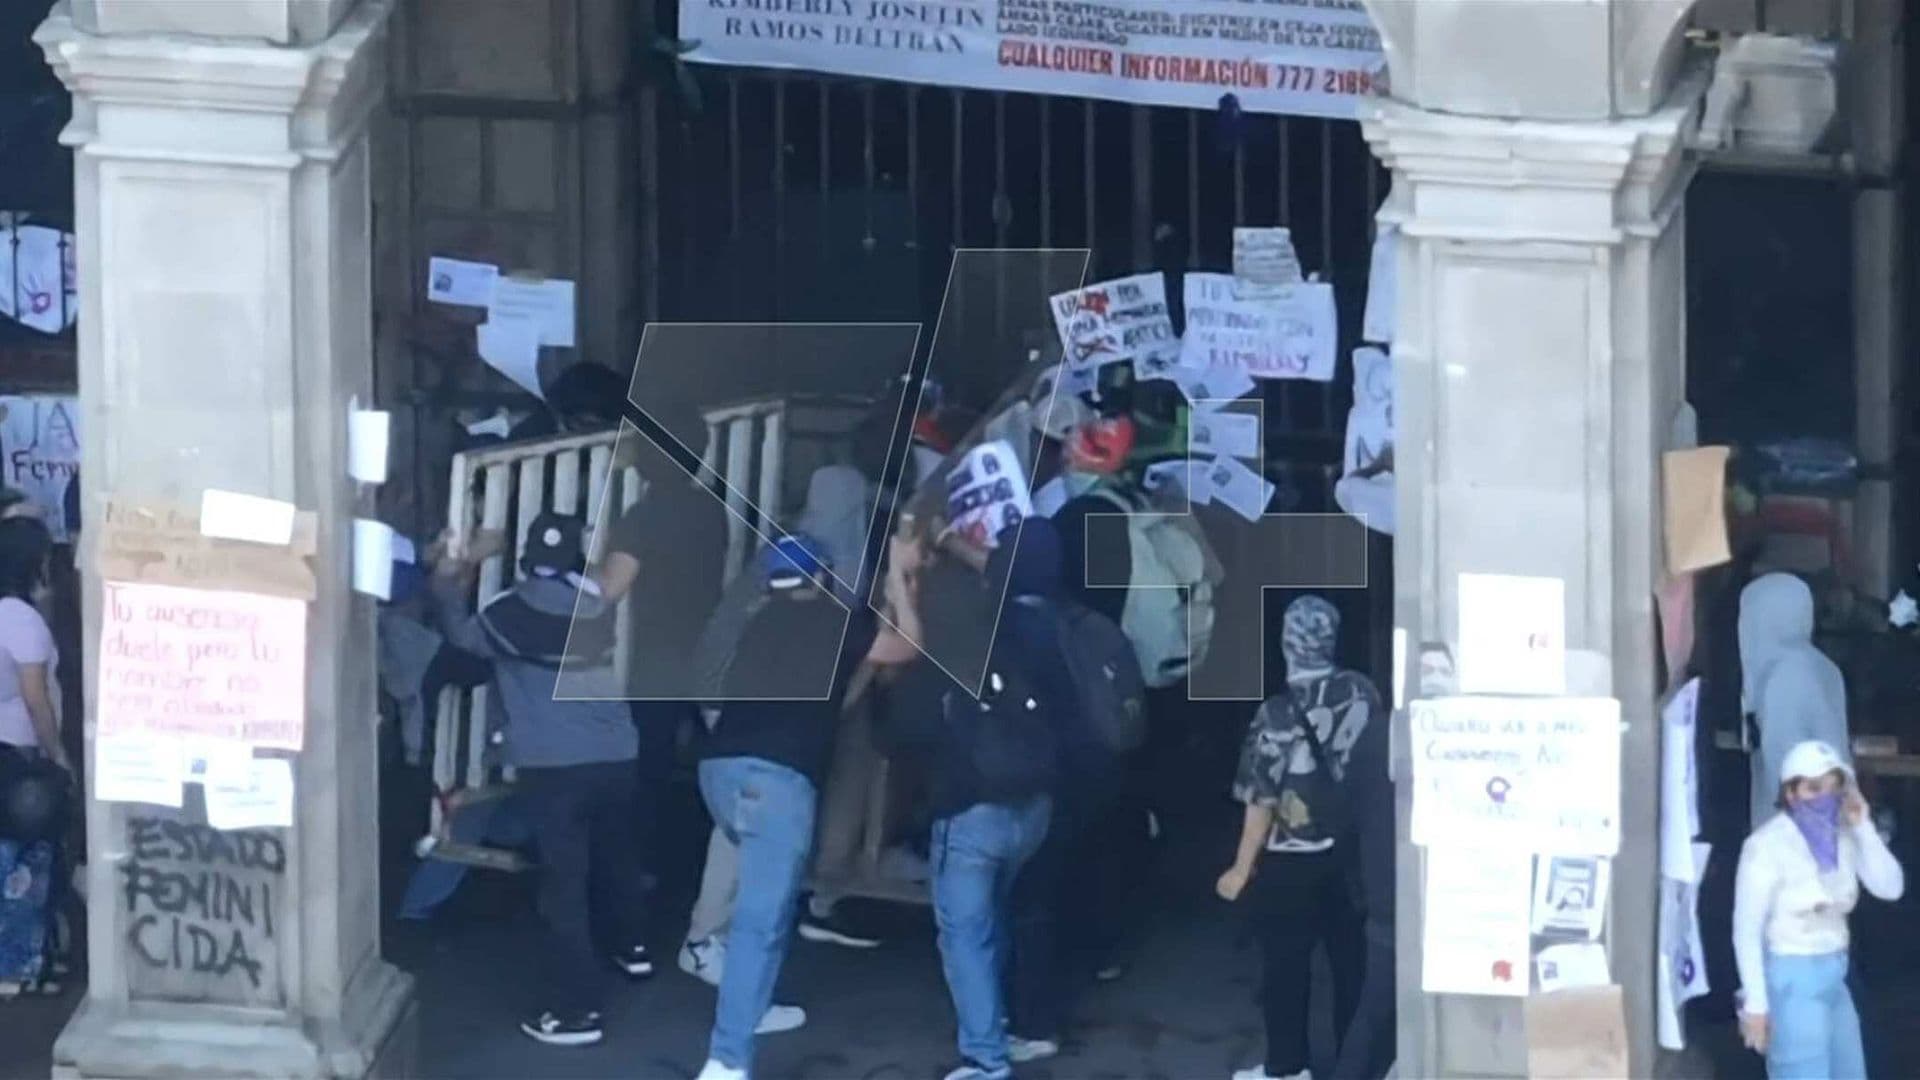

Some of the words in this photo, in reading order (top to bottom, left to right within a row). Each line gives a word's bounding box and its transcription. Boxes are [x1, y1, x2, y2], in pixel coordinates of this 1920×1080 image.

[726, 17, 823, 40] RAMOS
[866, 1, 983, 26] JOSELIN
[998, 39, 1113, 75] CUALQUIER
[1120, 52, 1268, 88] INFORMACIÓN
[1275, 64, 1314, 91] 777
[128, 914, 262, 989] CIDA
